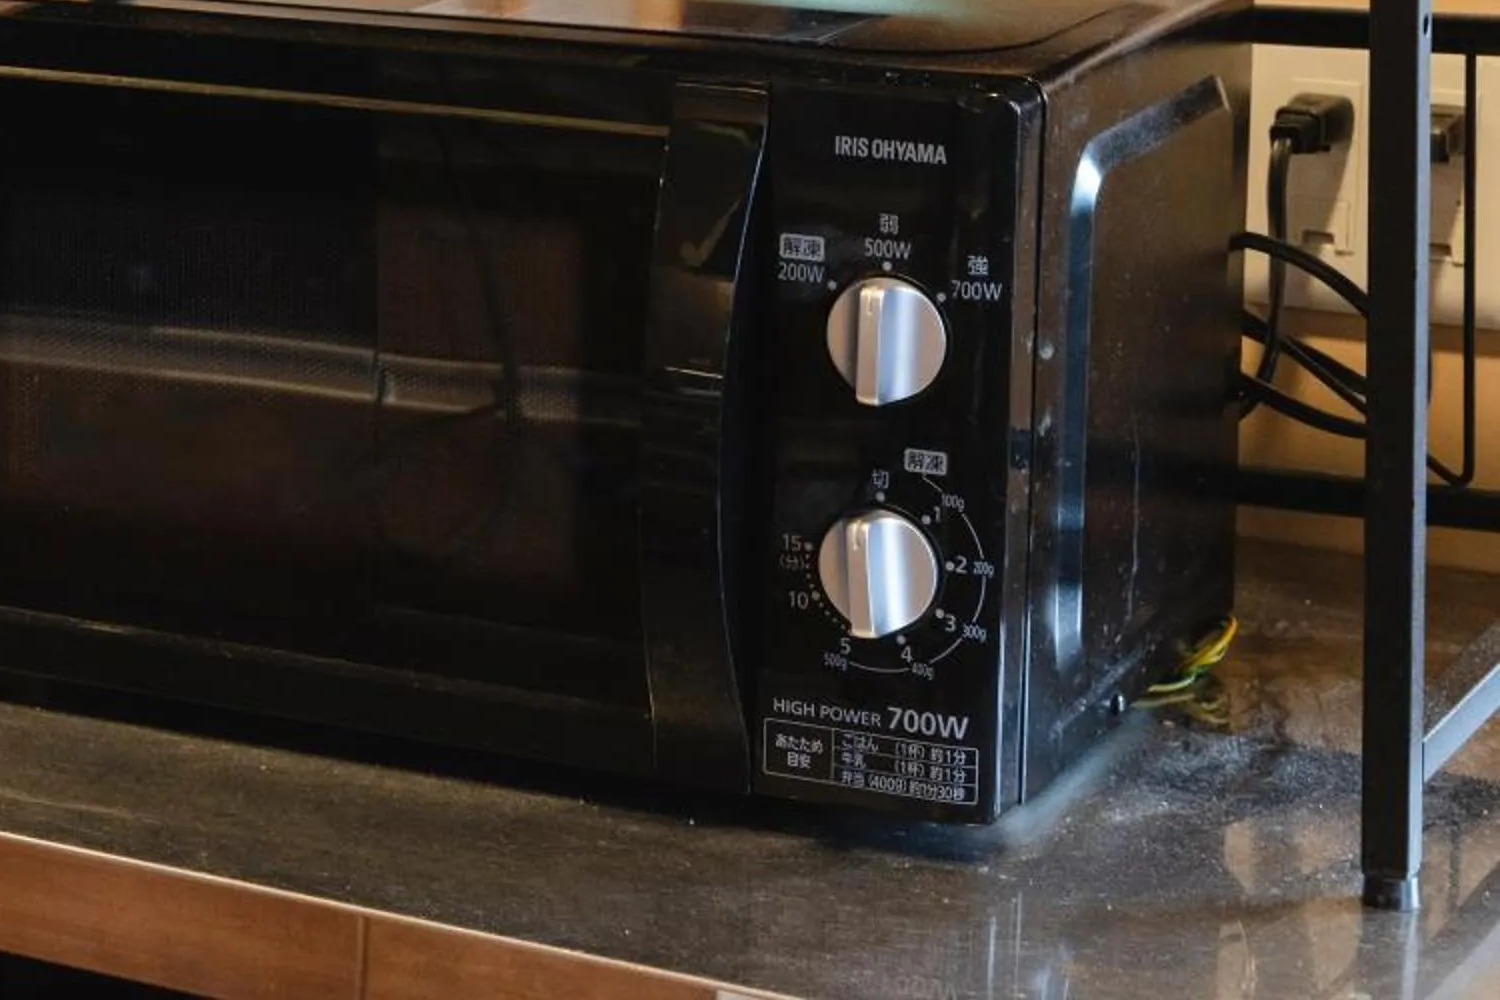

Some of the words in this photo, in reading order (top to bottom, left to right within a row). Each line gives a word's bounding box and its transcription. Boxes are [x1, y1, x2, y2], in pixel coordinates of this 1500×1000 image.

[835, 135, 868, 158] IRIS
[871, 138, 948, 165] OHYAMA
[878, 213, 899, 235] 弱
[781, 235, 823, 260] 解凍
[864, 238, 911, 260] 500W
[777, 262, 825, 284] 200W
[967, 255, 989, 276] 強
[951, 280, 1003, 301] 700W
[907, 451, 945, 474] 解凍
[872, 469, 889, 489] 切
[933, 507, 942, 522] 1
[781, 534, 802, 551] 15
[955, 556, 967, 574] 2
[788, 591, 809, 611] 10
[946, 614, 957, 632] 3
[840, 638, 851, 656] 5
[901, 645, 913, 663] 4
[772, 697, 816, 718] HIGH
[819, 704, 882, 728] POWER
[886, 706, 970, 741] 700W
